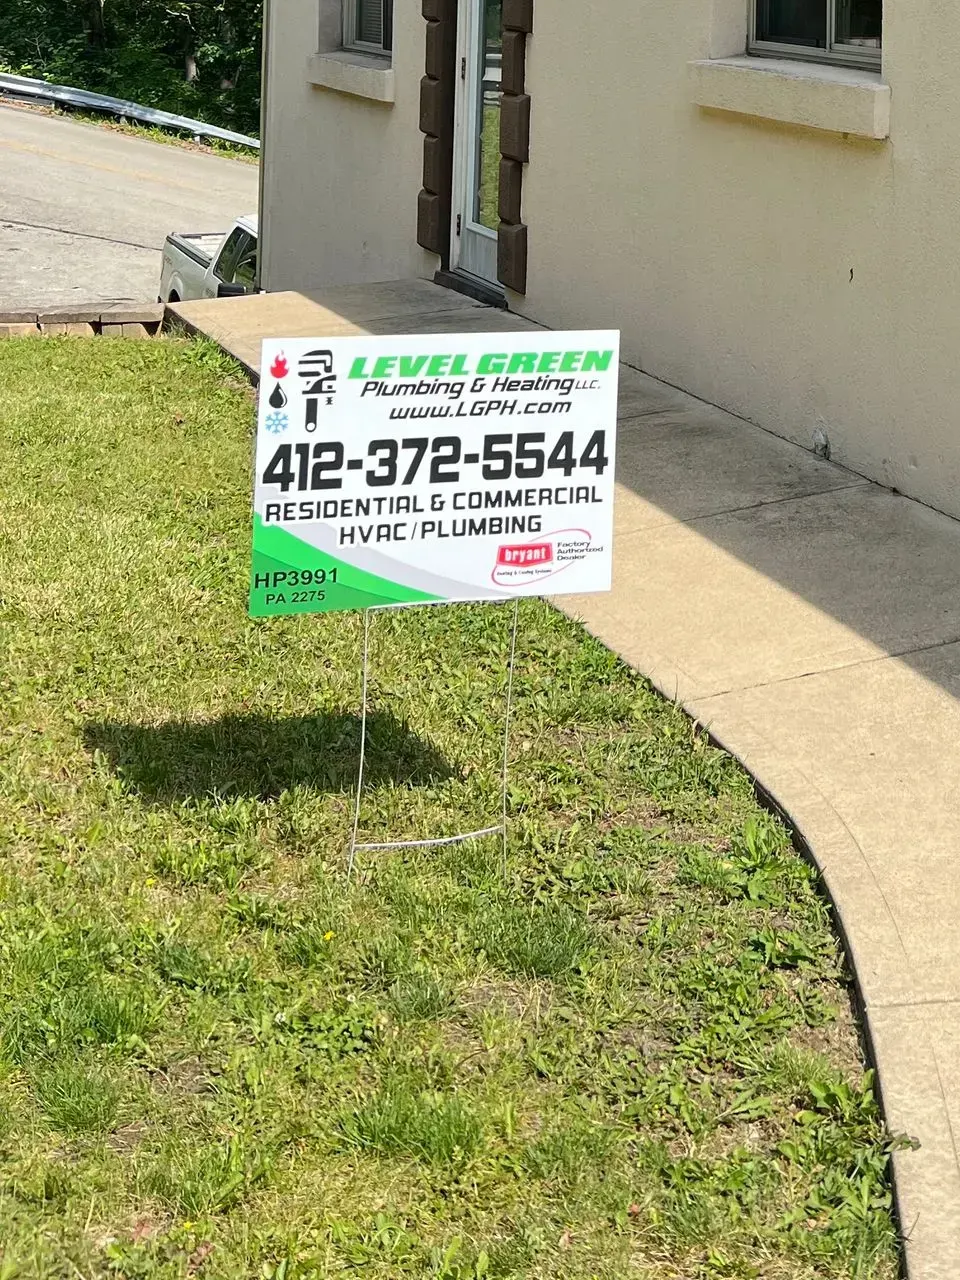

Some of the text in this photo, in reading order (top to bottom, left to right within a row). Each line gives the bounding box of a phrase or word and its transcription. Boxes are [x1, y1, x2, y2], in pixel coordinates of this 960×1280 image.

[347, 349, 615, 380] LEVEL GREEN
[360, 378, 466, 400] Plumbing
[470, 377, 486, 393] &
[491, 375, 575, 396] Heating
[389, 399, 573, 420] www.LGPH.com
[261, 429, 609, 493] 412-372-5544
[264, 485, 604, 523] RESIDENTIAL & COMMERCIAL
[339, 514, 543, 545] HVAC/PLUMBING
[504, 547, 547, 563] bryant
[557, 541, 591, 549] Factory
[254, 567, 338, 589] HP3991
[265, 590, 326, 605] PA 2275
